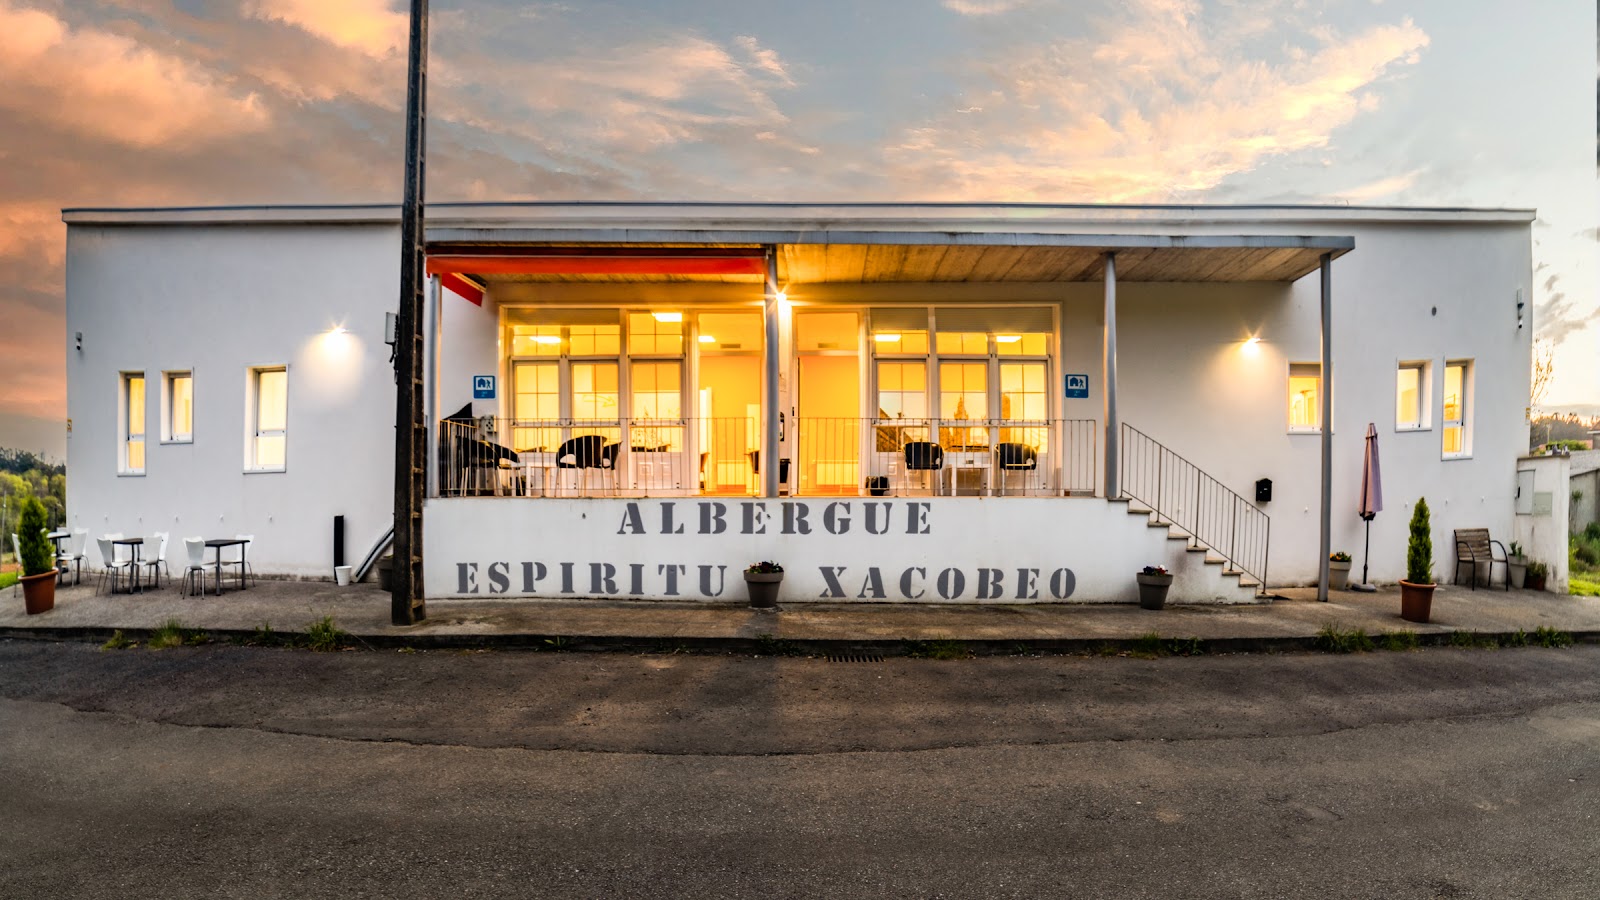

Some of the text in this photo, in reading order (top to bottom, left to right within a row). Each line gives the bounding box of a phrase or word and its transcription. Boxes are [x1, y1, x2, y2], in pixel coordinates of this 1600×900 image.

[617, 502, 931, 535] ALBERGUE
[456, 562, 1077, 601] ESPIRITU XACOBEO
